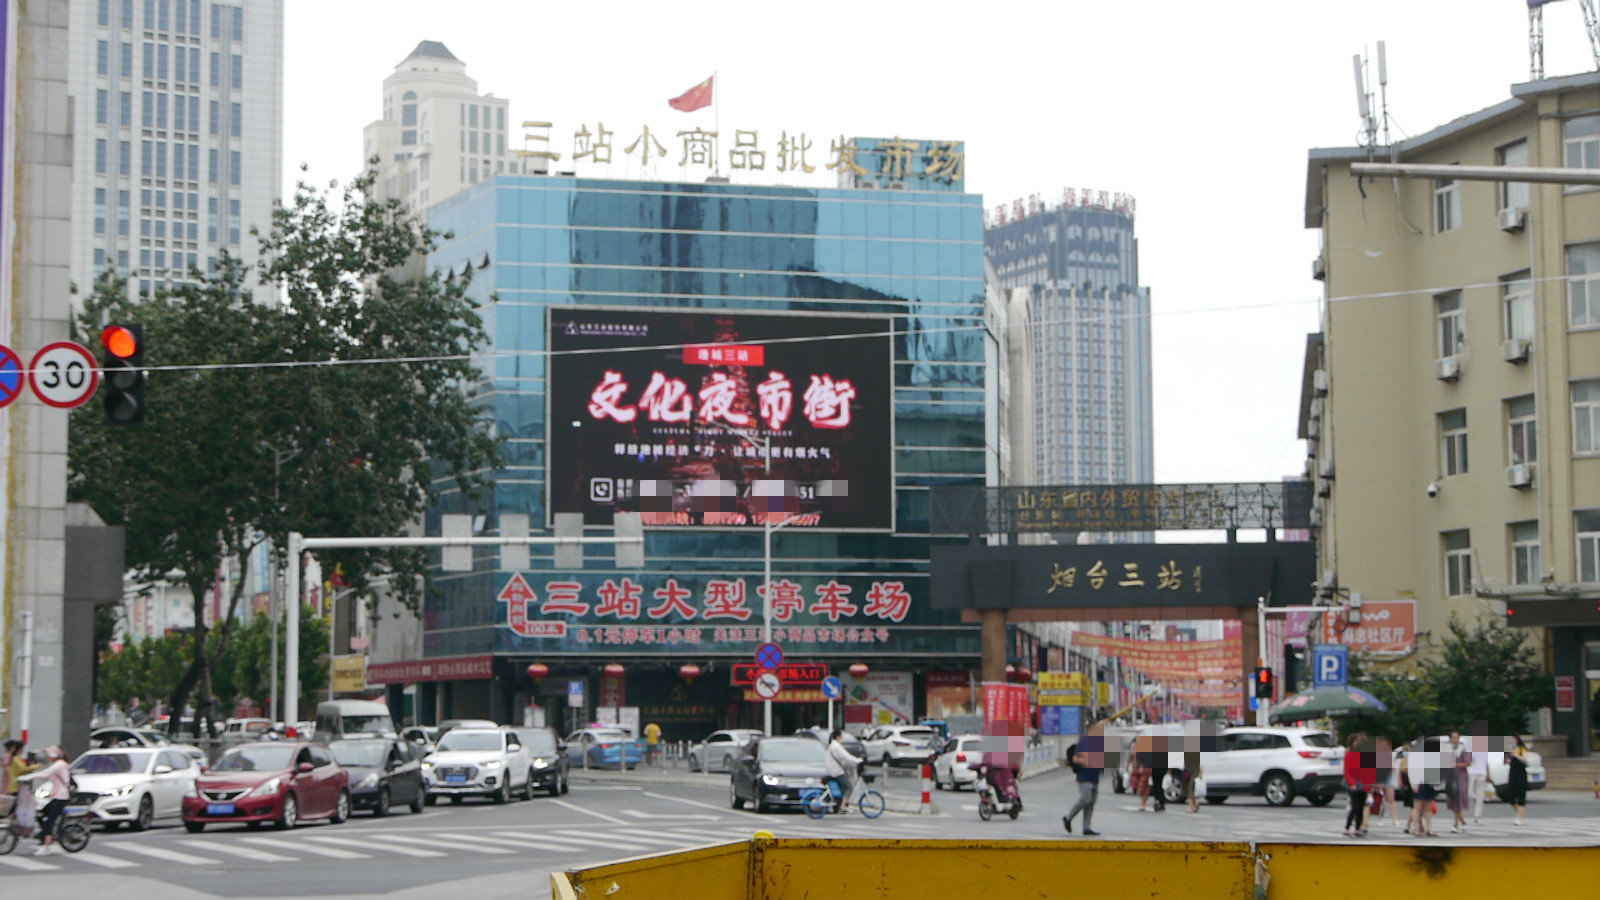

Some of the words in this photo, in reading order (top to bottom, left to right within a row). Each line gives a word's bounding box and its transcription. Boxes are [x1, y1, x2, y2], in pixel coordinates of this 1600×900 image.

[517, 121, 965, 182] 三站小商品批发市场
[42, 360, 85, 389] 30
[587, 369, 857, 430] 文化夜市街
[541, 577, 912, 622] 三站大型停车场
[745, 667, 820, 681] 小市场入口
[1320, 655, 1340, 681] P
